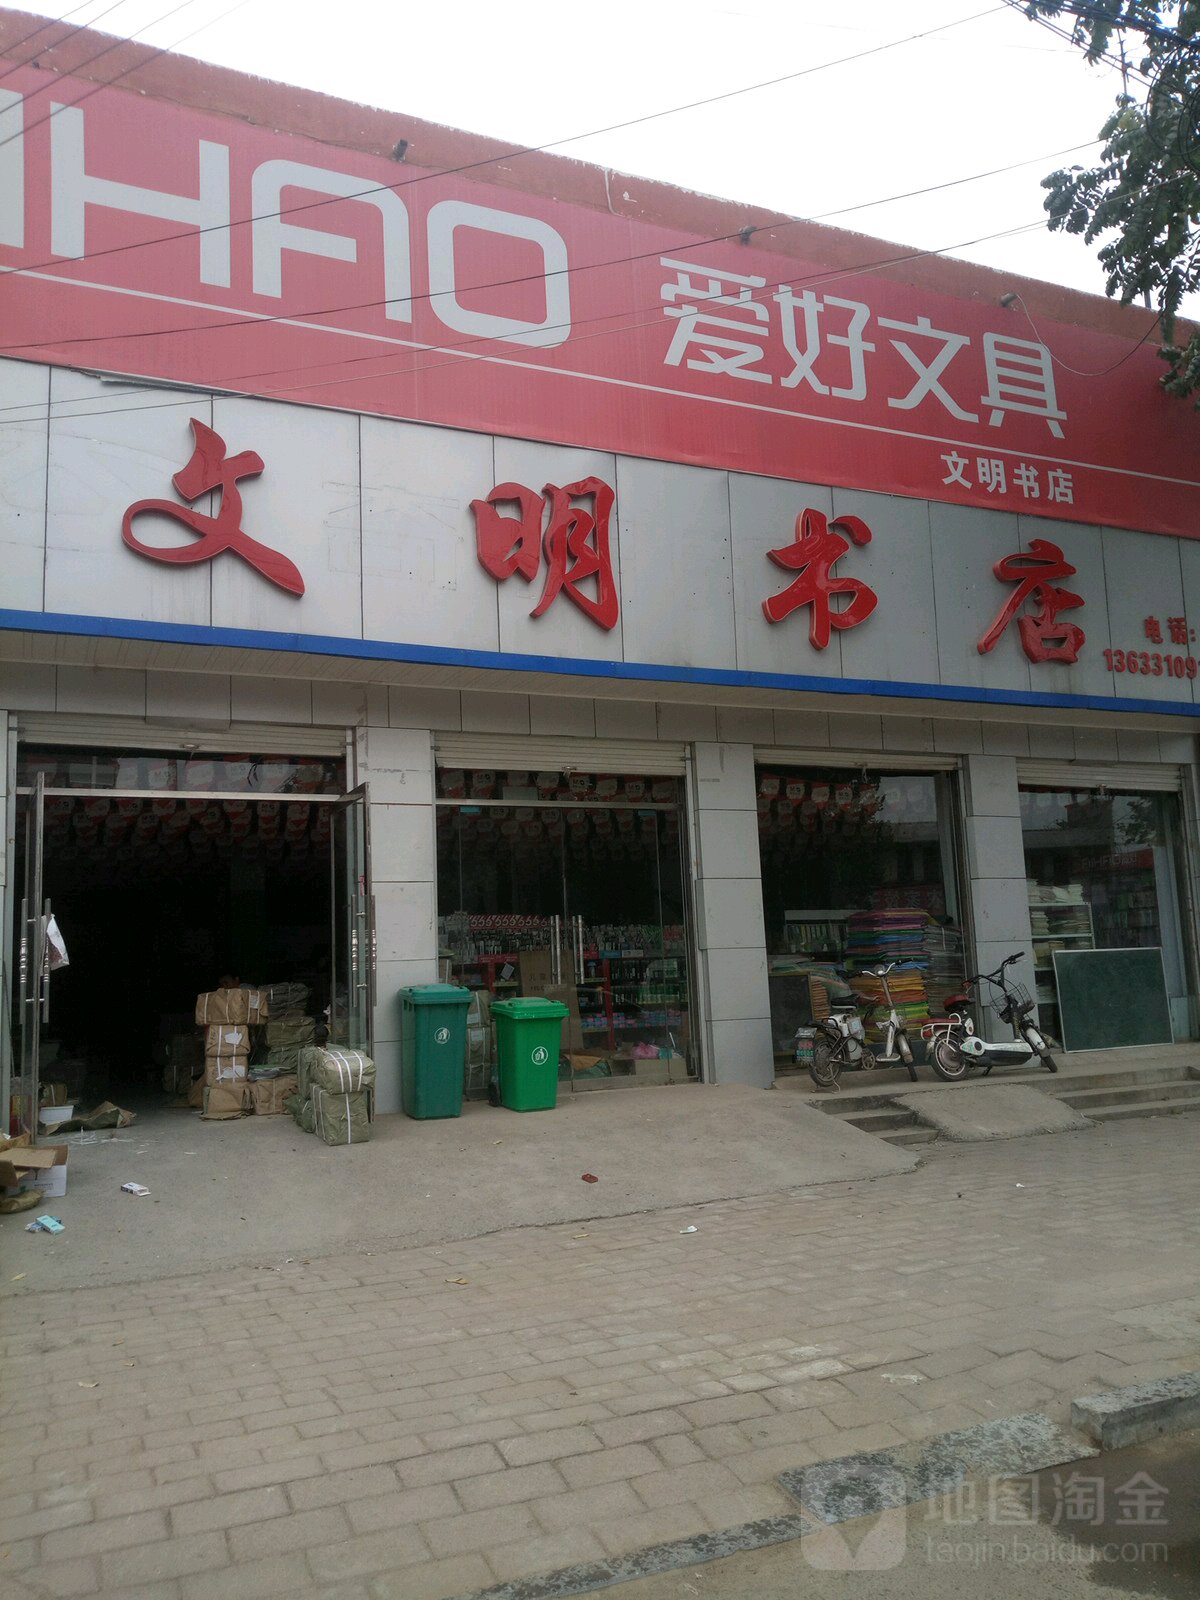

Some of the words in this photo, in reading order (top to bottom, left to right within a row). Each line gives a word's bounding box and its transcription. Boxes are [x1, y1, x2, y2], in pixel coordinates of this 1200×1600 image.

[660, 256, 1068, 440] 爱好文具
[940, 450, 1075, 505] 文明书店
[122, 416, 1086, 665] 文明书店
[1103, 648, 1200, 680] 13633109
